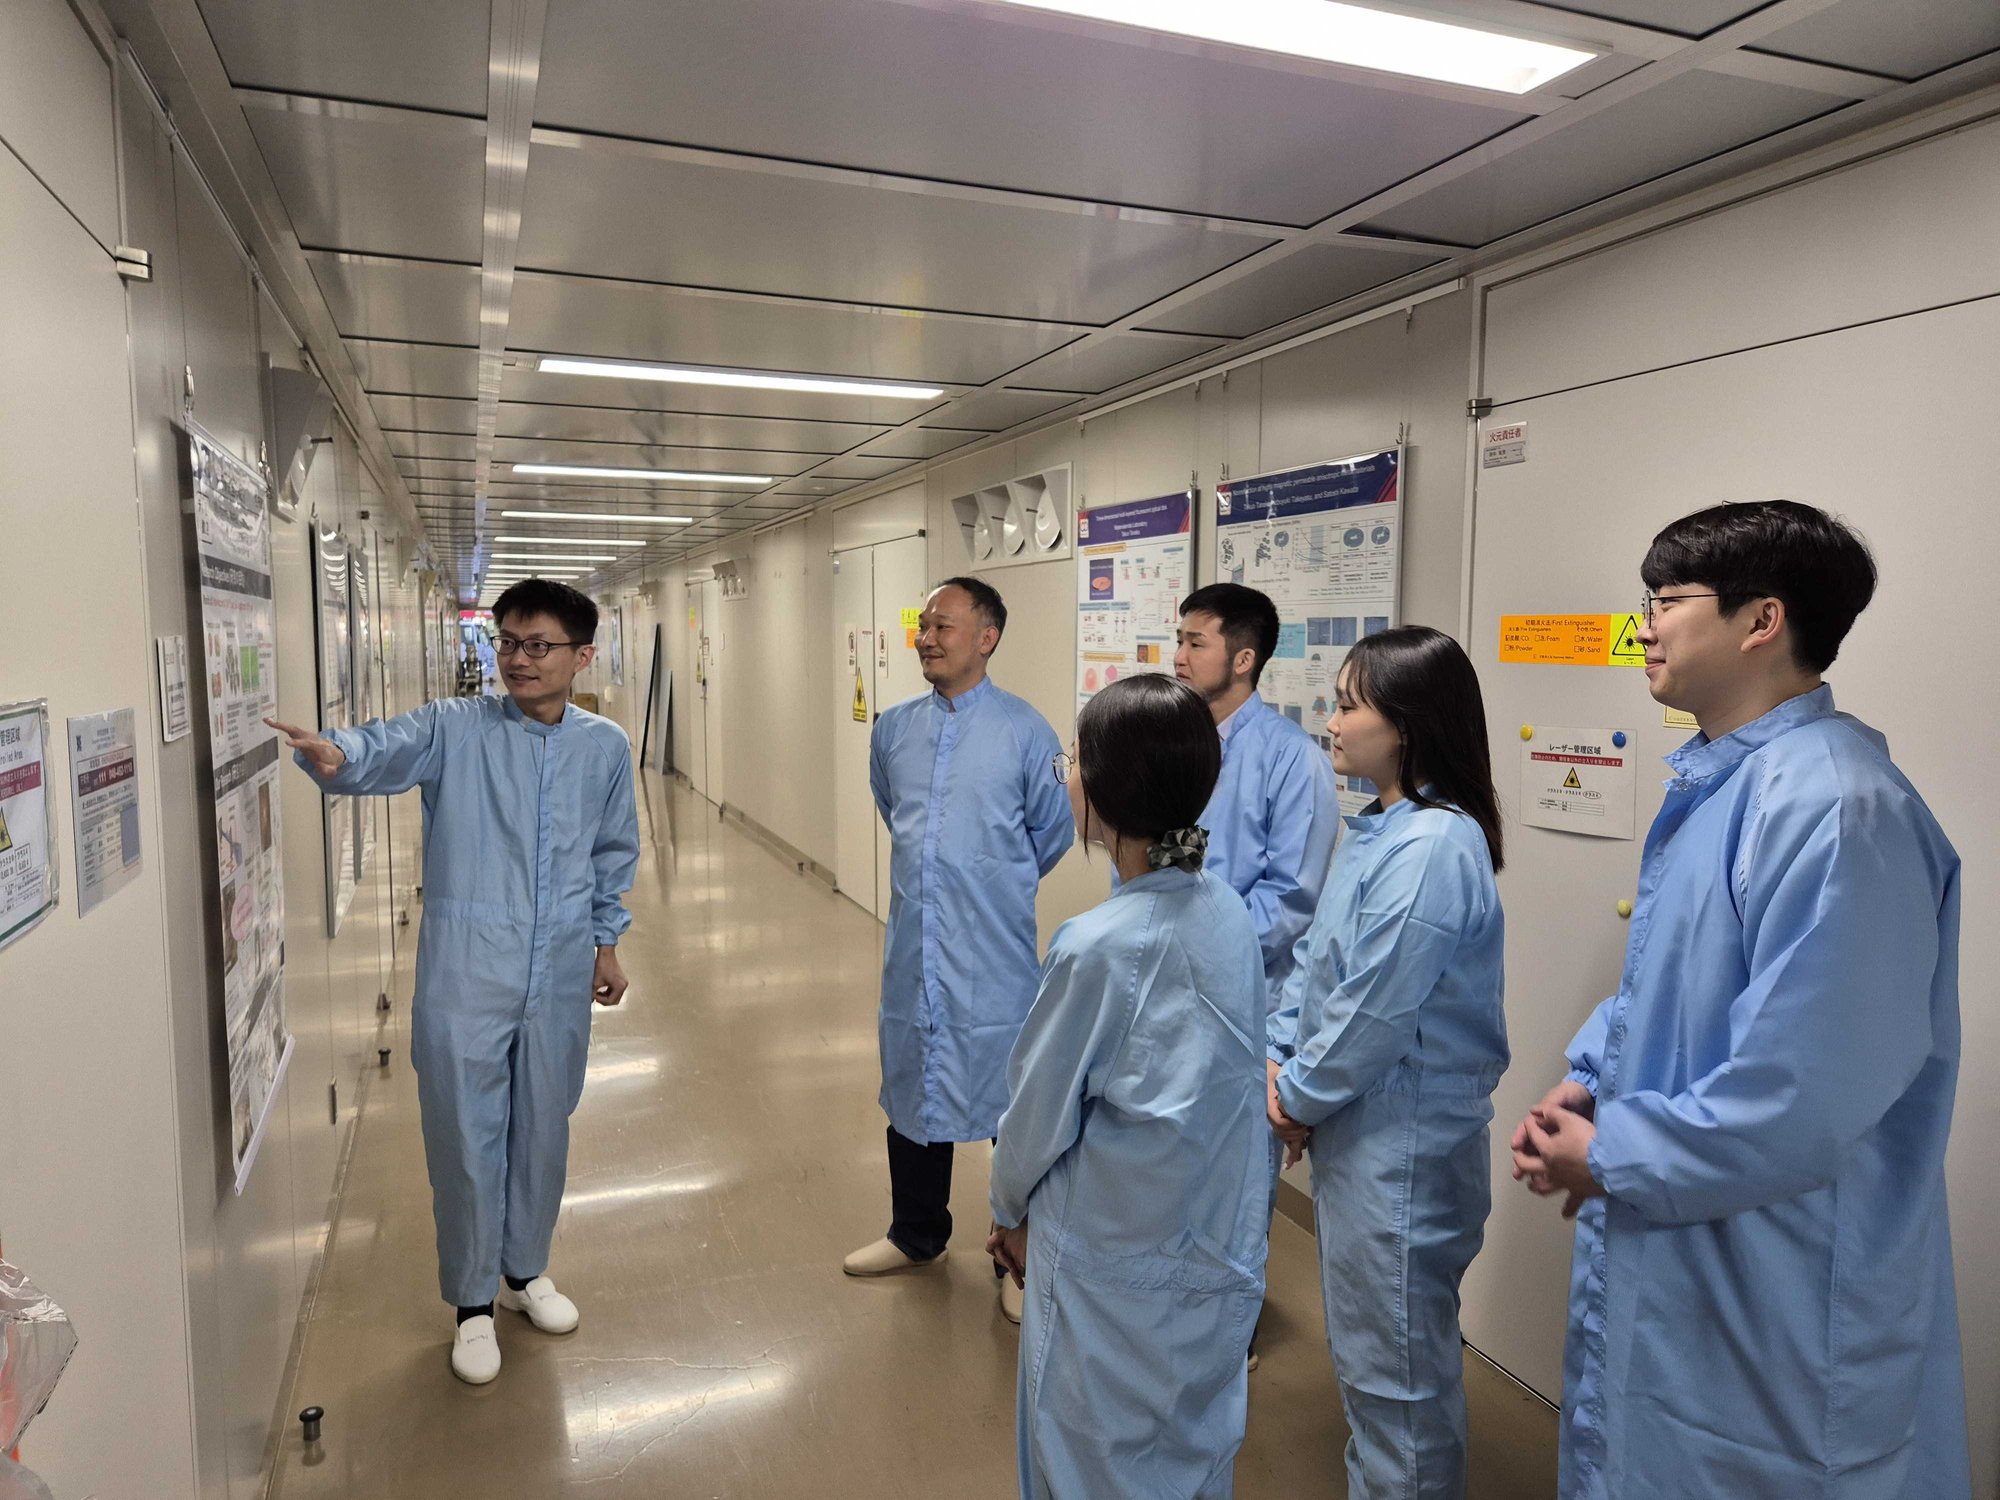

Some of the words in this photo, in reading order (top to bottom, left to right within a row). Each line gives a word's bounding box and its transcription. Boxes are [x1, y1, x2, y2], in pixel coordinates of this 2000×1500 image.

[1489, 428, 1521, 443] 火元責任者
[1549, 744, 1602, 755] レーザー管理区域
